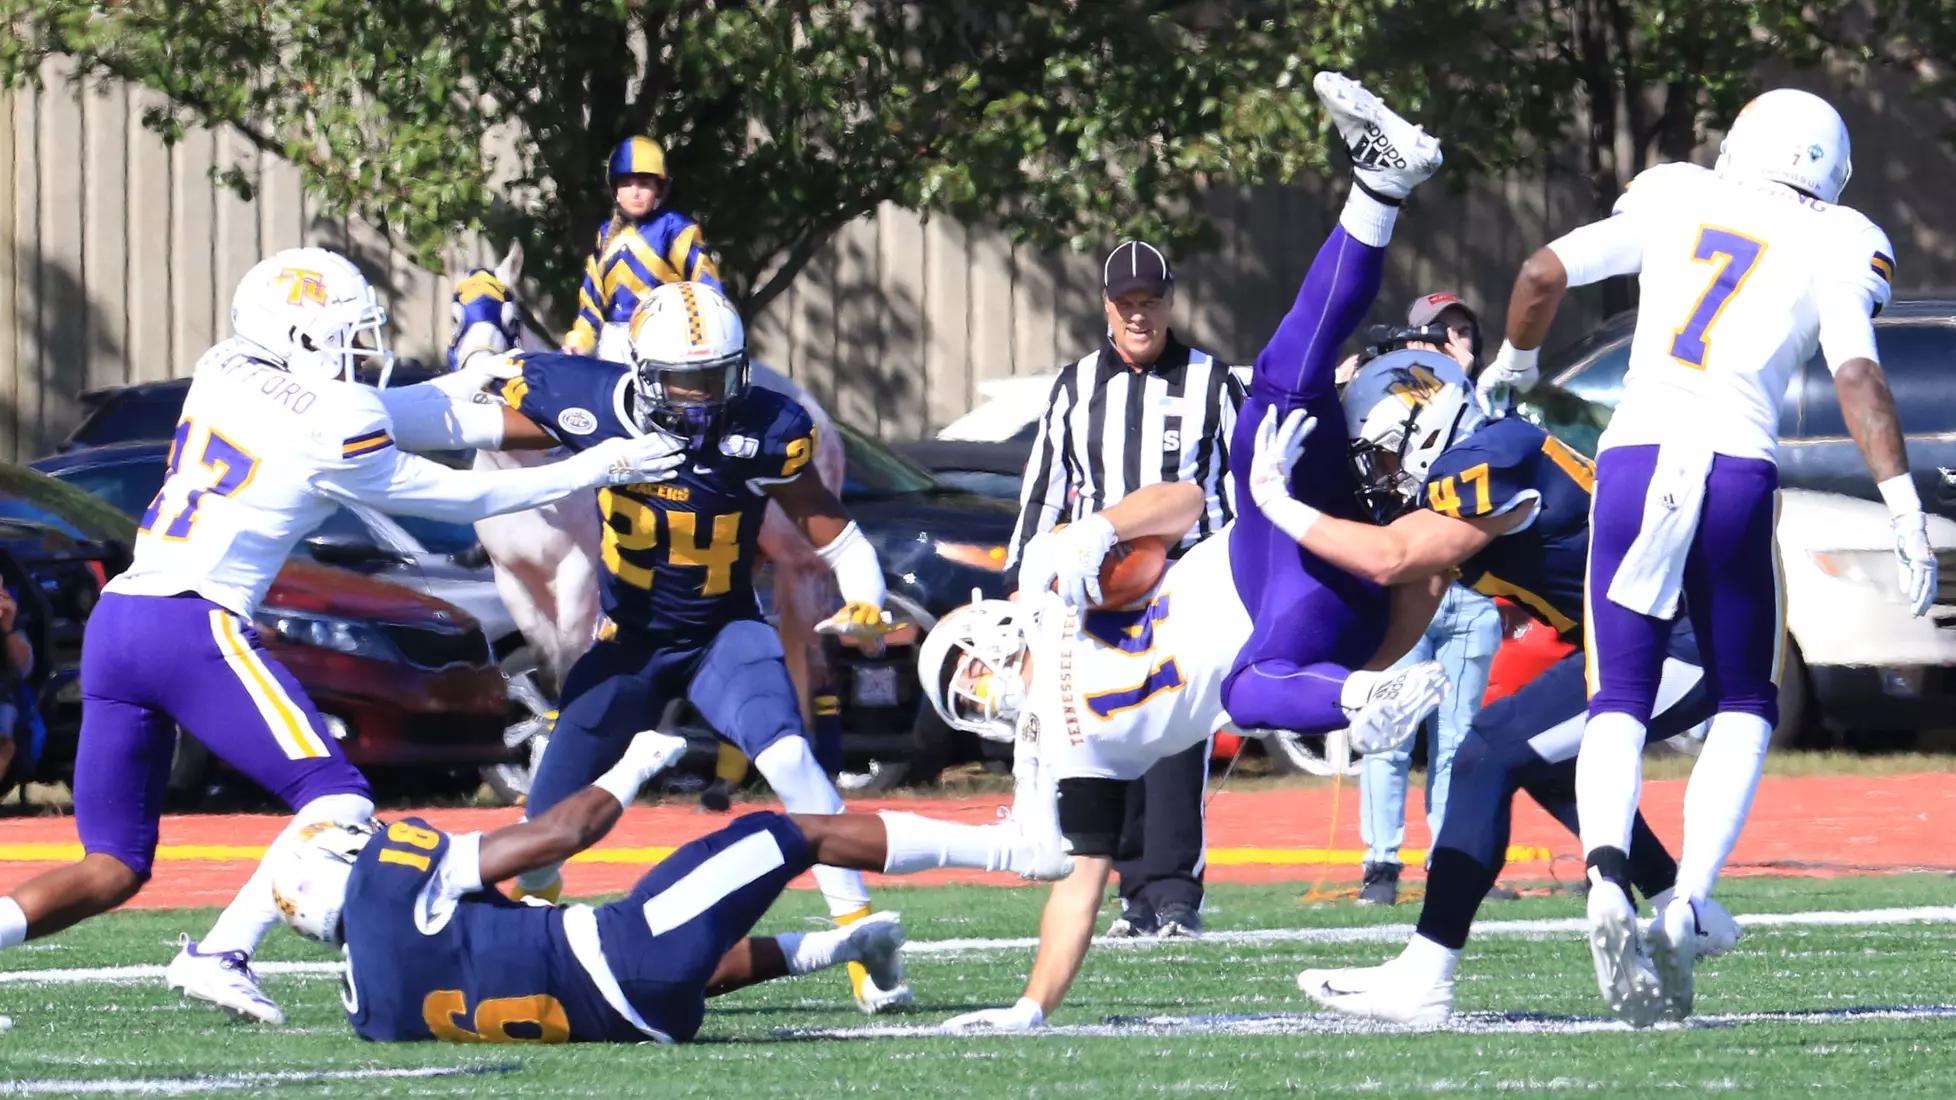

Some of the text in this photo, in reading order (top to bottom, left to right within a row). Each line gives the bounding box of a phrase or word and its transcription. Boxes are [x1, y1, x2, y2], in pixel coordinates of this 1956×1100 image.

[1364, 121, 1407, 169] adidas
[1668, 223, 1769, 371] 7
[1163, 429, 1181, 452] S
[1427, 462, 1493, 519] 47
[598, 486, 743, 597] 24
[1060, 605, 1085, 747] TENNESSEE TEC
[1081, 590, 1187, 721] 14
